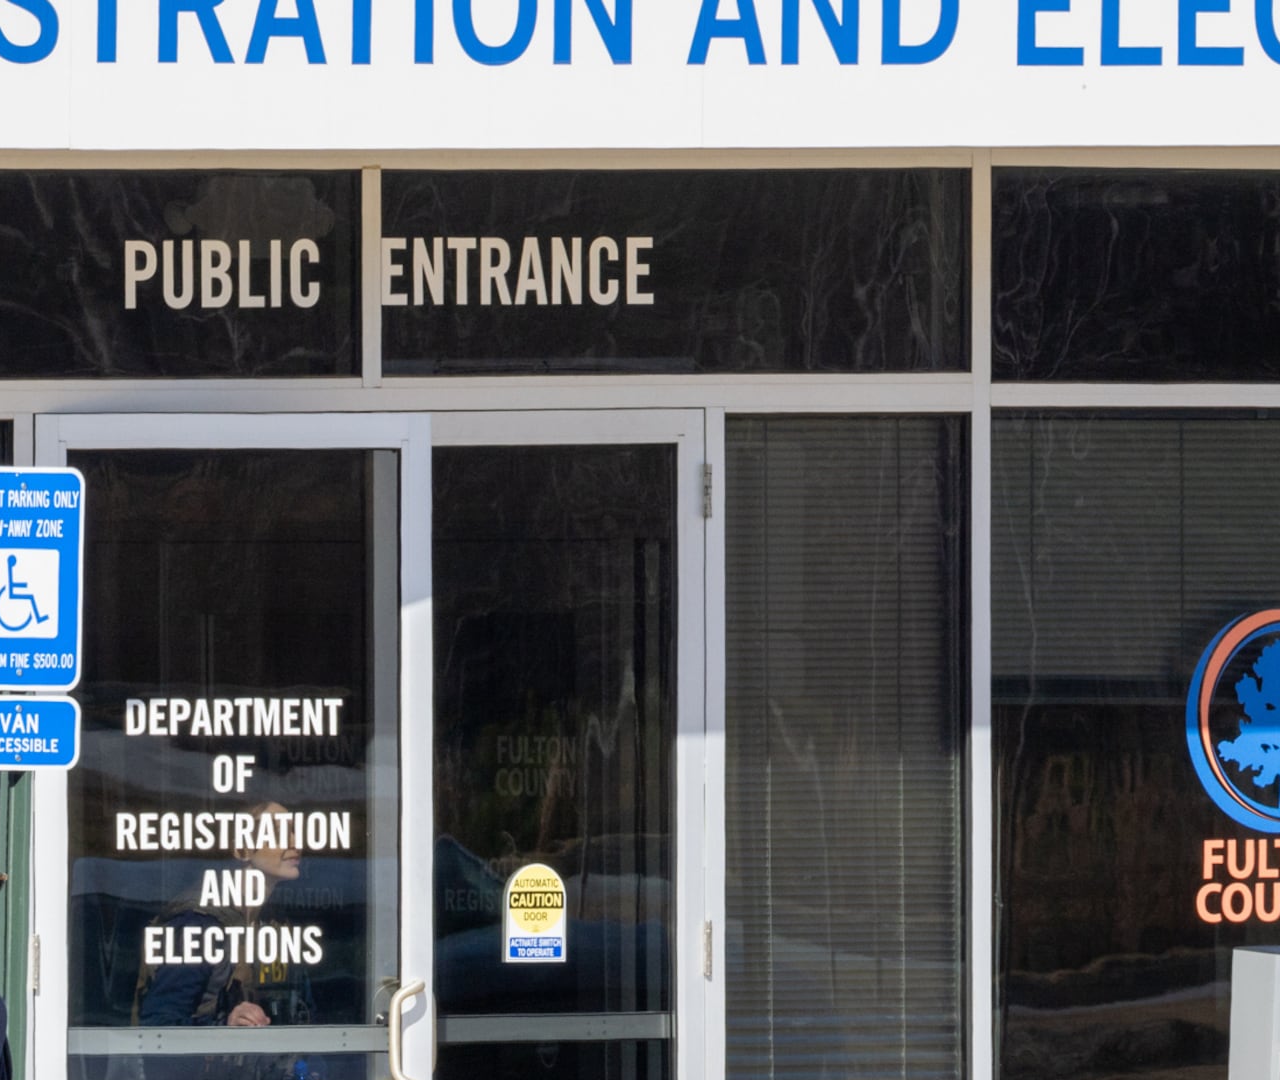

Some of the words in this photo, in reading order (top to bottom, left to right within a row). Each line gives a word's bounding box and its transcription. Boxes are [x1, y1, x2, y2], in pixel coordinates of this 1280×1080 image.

[123, 239, 321, 310] PUBLIC
[382, 236, 654, 307] ENTRANCE
[8, 490, 51, 508] PARKING
[54, 490, 80, 509] ONLY
[36, 519, 64, 538] ZONE
[10, 653, 30, 669] FINE
[33, 653, 74, 669] $500.00
[0, 713, 39, 734] VAN
[125, 698, 343, 737] DEPARTMENT
[212, 755, 255, 793] OF
[116, 811, 351, 851] REGISTRATION
[199, 869, 266, 908] AND
[514, 878, 559, 888] AUTOMATIC
[510, 893, 562, 907] CAUTION
[524, 911, 548, 921] DOOR
[143, 926, 324, 965] ELECTIONS
[517, 948, 526, 956] TO
[527, 948, 555, 956] OPERATE
